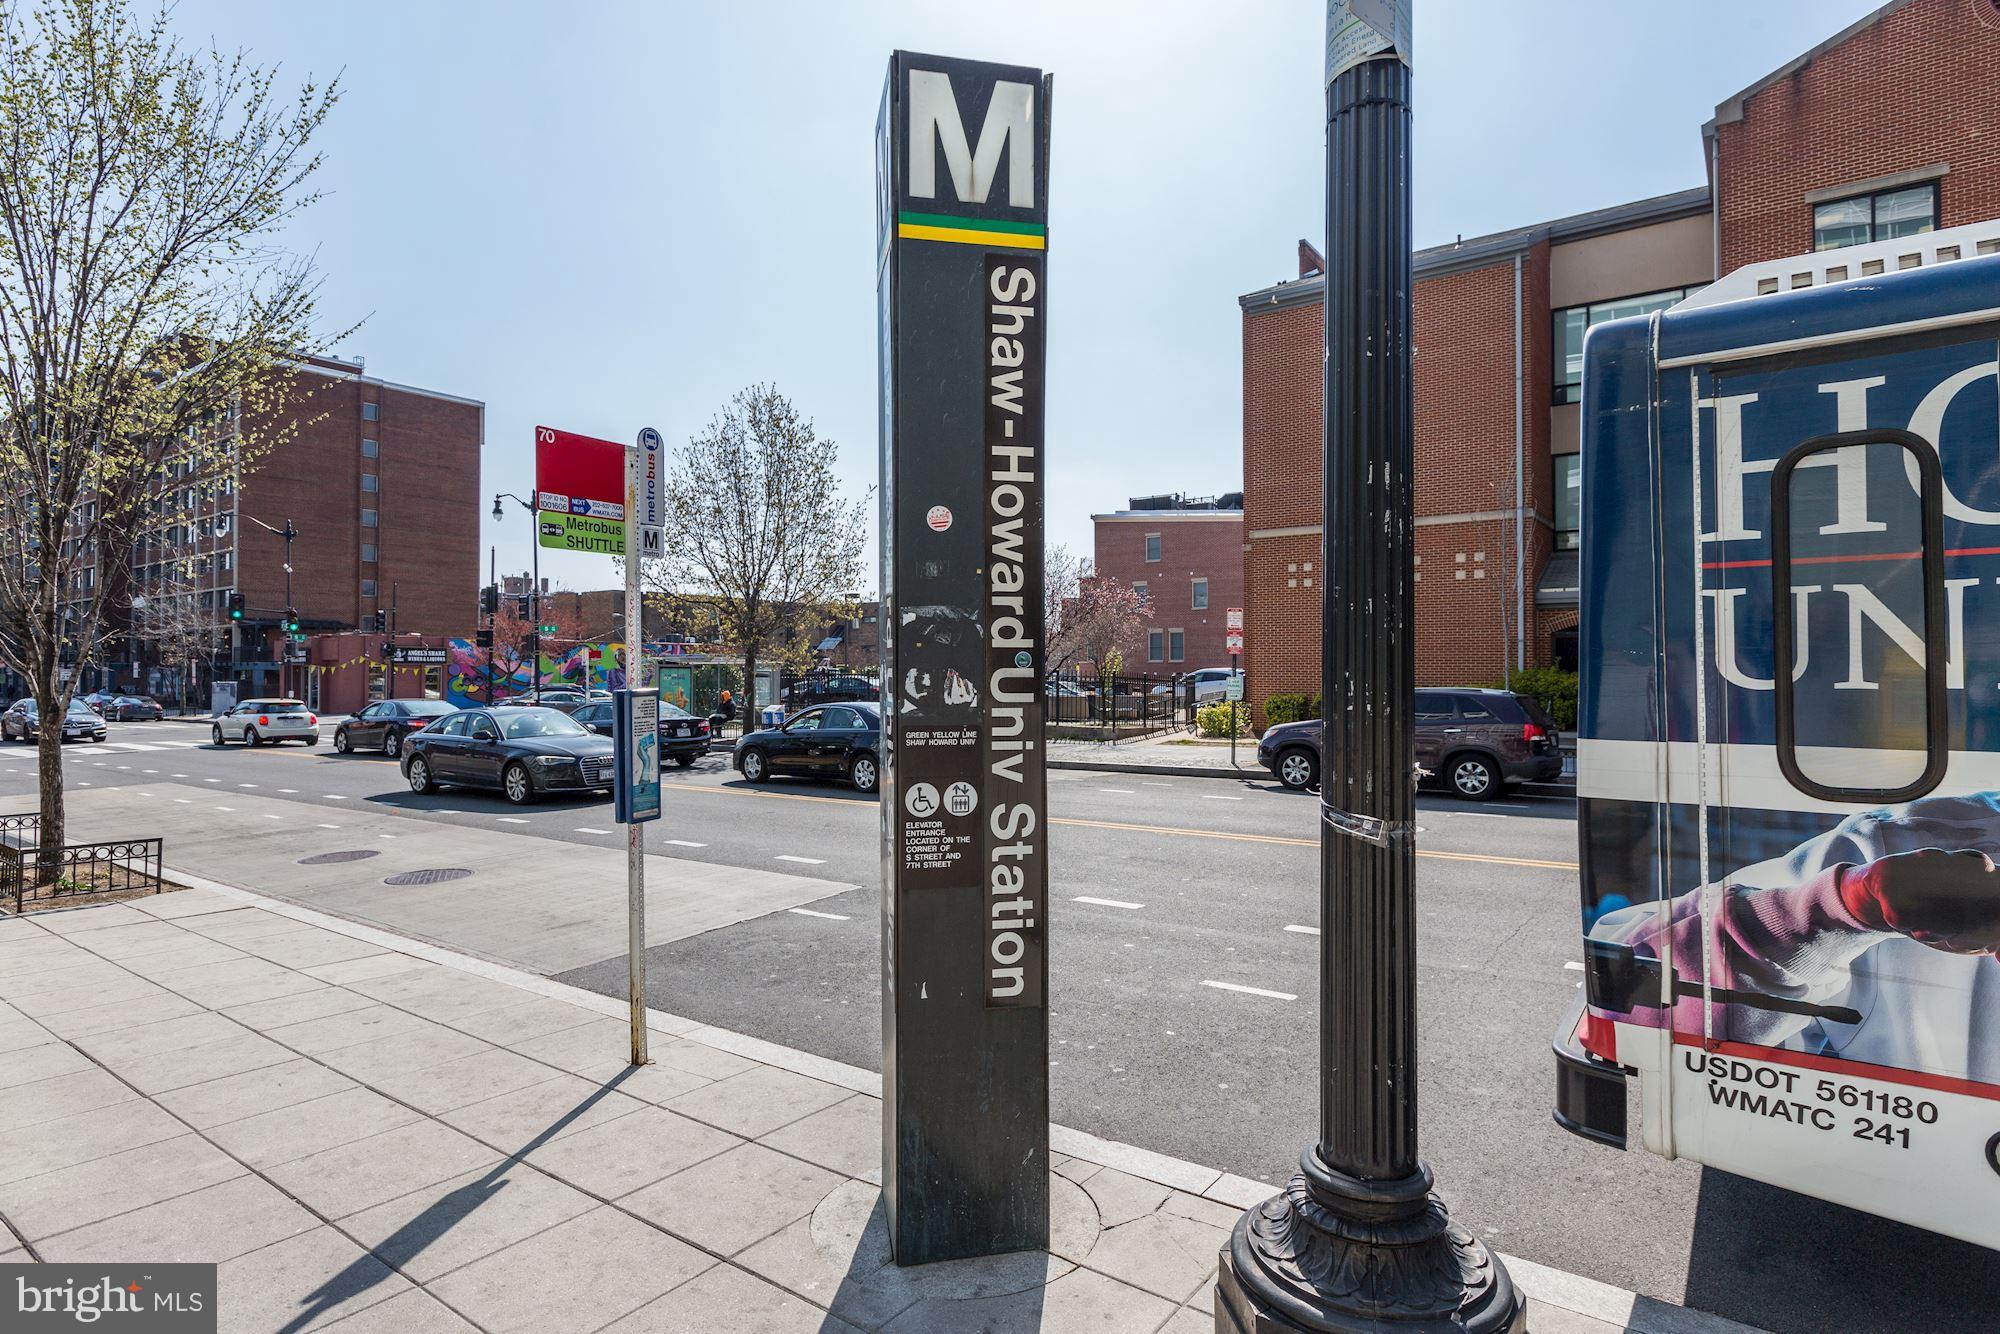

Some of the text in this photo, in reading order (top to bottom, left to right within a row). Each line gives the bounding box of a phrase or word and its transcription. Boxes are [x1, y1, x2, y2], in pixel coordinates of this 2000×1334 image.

[909, 69, 1034, 208] M
[538, 428, 555, 444] 70
[646, 453, 656, 522] metrobus
[571, 498, 586, 506] NEXT
[566, 517, 622, 535] Metrobus
[567, 535, 624, 553] SHUTTLE
[644, 530, 658, 549] M
[1702, 577, 2000, 691] UN
[990, 667, 1035, 783] Univ
[906, 731, 930, 739] GREEN
[962, 730, 977, 738] LINE
[929, 738, 958, 746] HOWARD
[906, 821, 943, 829] ELEVATOR
[906, 829, 946, 837] ENTRANCE
[905, 837, 940, 845] LOCATED
[942, 836, 954, 844] ON
[905, 845, 937, 853] CORNER
[905, 860, 951, 869] 7TH STREET
[914, 853, 943, 861] STREET
[945, 852, 961, 860] AND
[990, 803, 1036, 997] Station
[1685, 1051, 1939, 1124] USDOT 561180
[1708, 1082, 1910, 1149] WMATC 241
